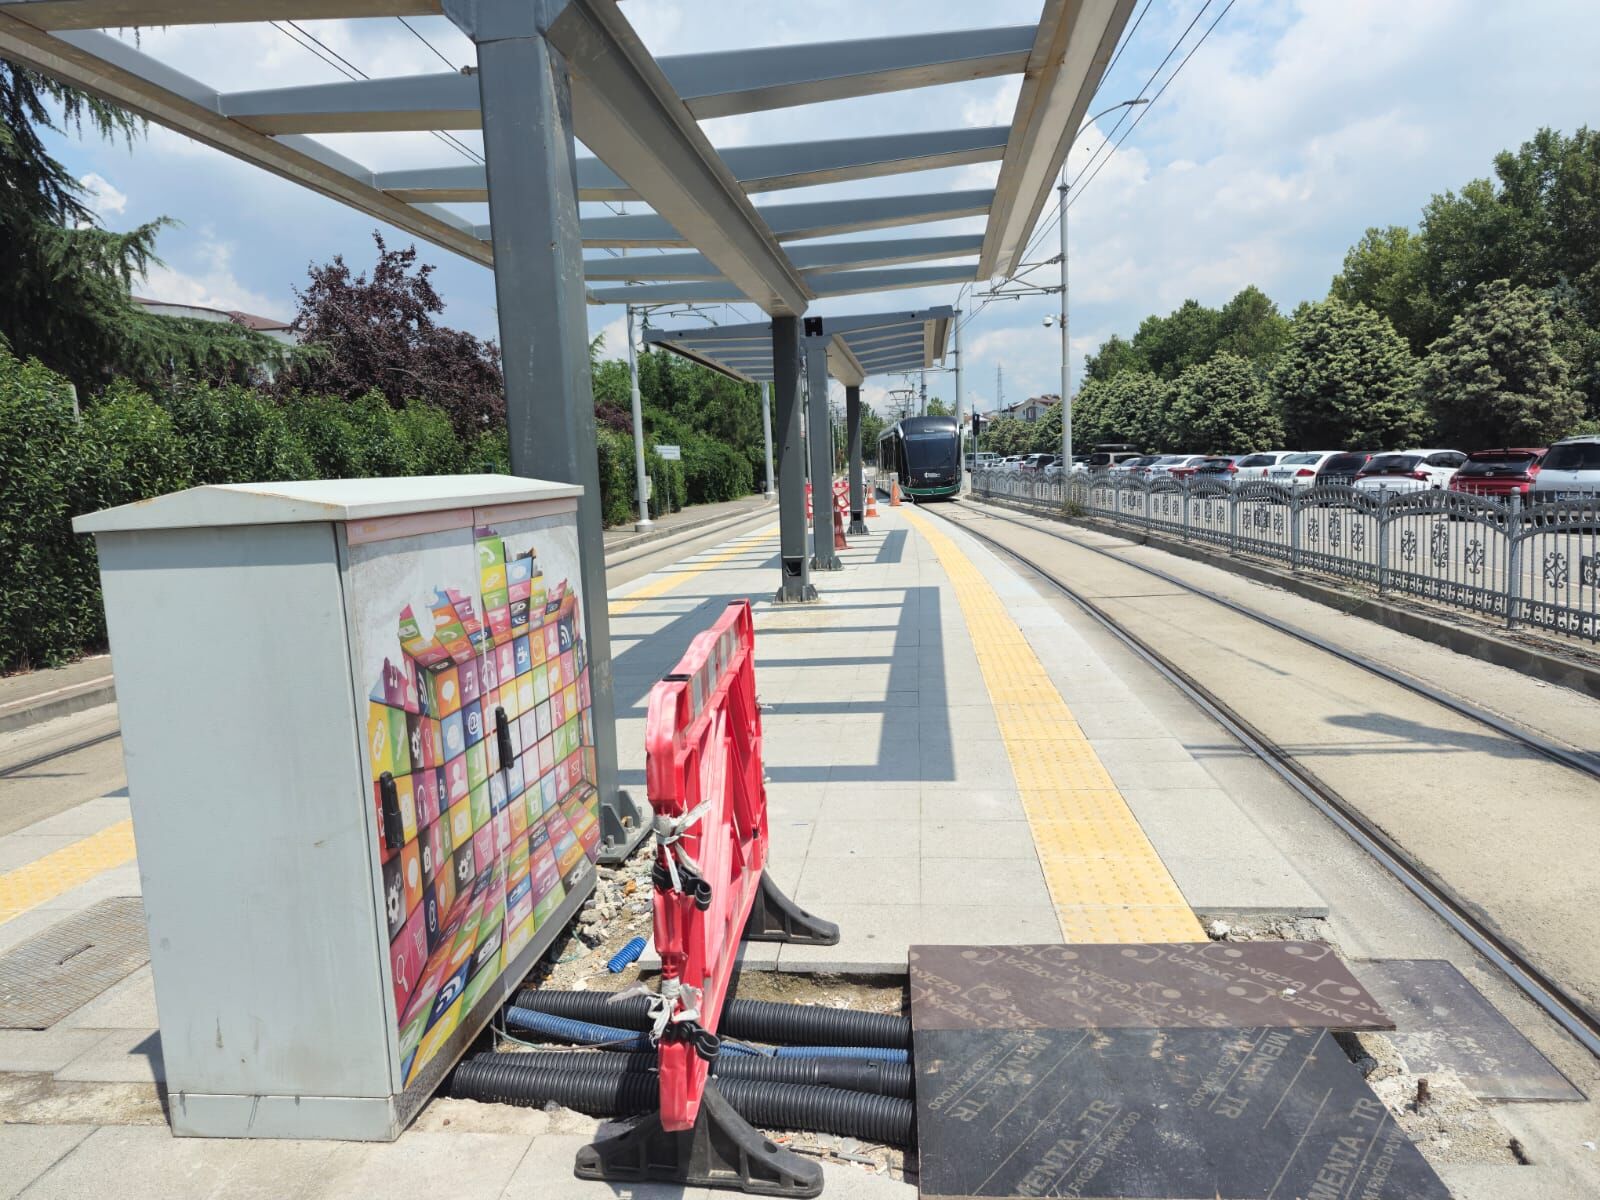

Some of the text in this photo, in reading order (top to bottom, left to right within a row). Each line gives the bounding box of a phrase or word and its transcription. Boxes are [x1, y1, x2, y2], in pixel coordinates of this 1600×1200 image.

[1168, 953, 1235, 981] SVEZA
[1235, 962, 1307, 992] SVEZA
[1280, 992, 1358, 1023] SVEZA
[951, 1099, 989, 1122] TR
[1078, 1100, 1116, 1122] TR
[1215, 1096, 1249, 1119] TR
[1307, 1136, 1366, 1200] MENTA
[1349, 1097, 1383, 1121] TR
